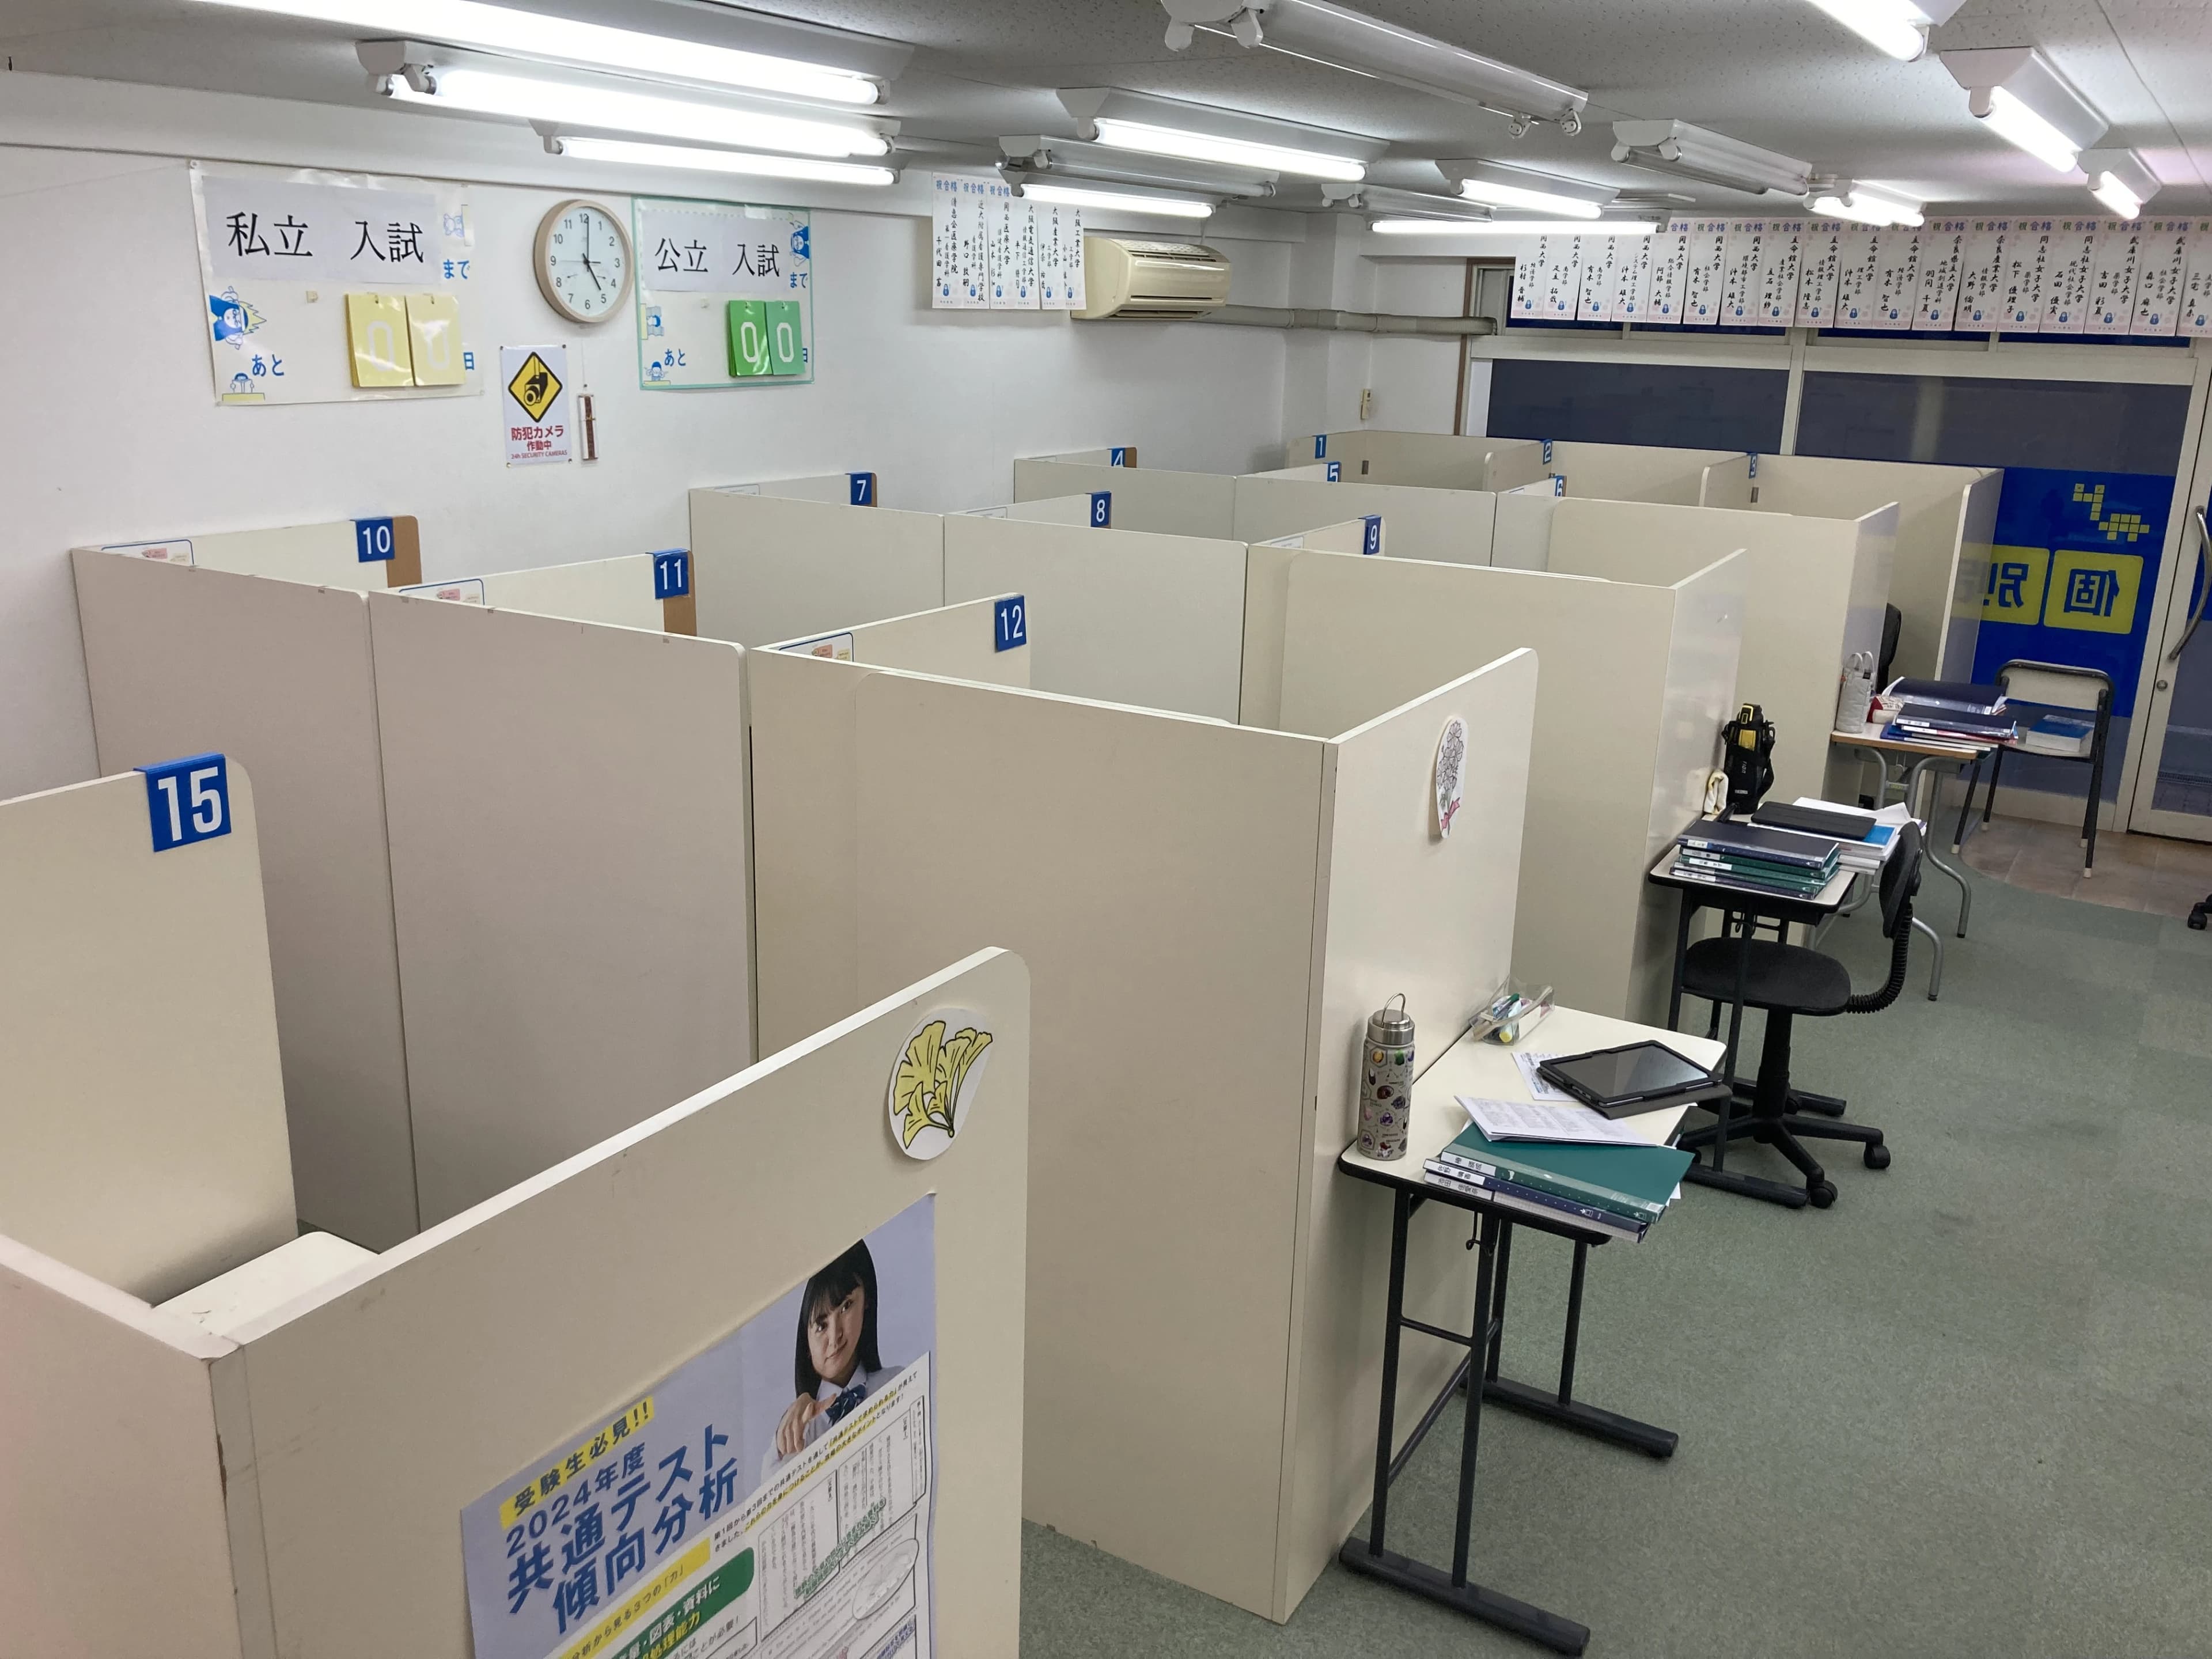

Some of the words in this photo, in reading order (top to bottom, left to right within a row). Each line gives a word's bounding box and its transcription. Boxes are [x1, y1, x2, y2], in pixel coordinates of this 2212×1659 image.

[564, 219, 573, 229] 11
[579, 213, 589, 224] 12
[598, 221, 603, 230] 1
[1698, 223, 1725, 232] 祝合格
[1734, 222, 1763, 232] 祝合格
[1772, 222, 1801, 232] 祝合格
[1811, 222, 1840, 232] 祝合格
[1933, 222, 1964, 231] 祝合格
[1975, 221, 2008, 231] 祝合格
[2018, 221, 2052, 231] 祝合格
[2063, 221, 2096, 231] 祝合格
[2108, 221, 2142, 231] 祝合格
[226, 211, 313, 256] 私立
[350, 221, 425, 263] 入試
[554, 233, 563, 244] 10
[609, 236, 615, 247] 2
[550, 256, 556, 266] 9
[654, 238, 709, 274] 公立
[732, 243, 780, 278] 入試
[1538, 235, 1547, 267] 関西大学
[1571, 235, 1581, 268] 関西大学
[1605, 235, 1615, 268] 関西大学
[1641, 235, 1650, 270] 関西大学
[1676, 236, 1687, 270] 関西大学
[1713, 236, 1724, 271] 関西大学
[1750, 236, 1761, 271] 関西大学
[1786, 236, 1799, 281] 立命館大学
[1826, 236, 1838, 281] 立命館大学
[1865, 236, 1878, 282] 立命館大学
[1906, 235, 1920, 282] 立命館大学
[443, 259, 471, 279] まで
[615, 258, 620, 268] 3
[1946, 234, 1963, 291] 奈良県立大学
[1989, 235, 2005, 293] 奈良産業大学
[2012, 260, 2022, 279] 松下
[2031, 235, 2049, 302] 同志社女子大学
[2074, 235, 2093, 303] 同志社女子大学
[2120, 236, 2139, 305] 武庫川女子大学
[2166, 236, 2186, 305] 武庫川女子大学
[556, 277, 562, 287] 8
[611, 278, 616, 288] 4
[790, 271, 808, 289] まで
[1656, 267, 1664, 283] 阿部
[1766, 267, 1775, 285] 立石
[1805, 268, 1814, 286] 松本
[1815, 259, 1825, 302] 情報理工学部
[1854, 267, 1864, 296] 理工学部
[1967, 271, 1976, 290] 大野
[2054, 271, 2064, 288] 石田
[2064, 260, 2078, 306] 現代社会学部
[2098, 270, 2109, 289] 吉田
[568, 293, 574, 304] 7
[585, 300, 590, 309] 6
[601, 294, 607, 304] 5
[664, 348, 687, 367] あと
[740, 321, 760, 363] 0
[776, 322, 795, 363] 0
[251, 354, 285, 377] あと
[463, 351, 475, 370] 日
[511, 425, 564, 441] 防犯カメラ
[527, 441, 552, 452] 作動中
[1319, 437, 1324, 456] 1
[1544, 442, 1551, 462] 2
[1113, 450, 1124, 467] 4
[1750, 456, 1756, 476] 3
[1329, 464, 1339, 483] 5
[856, 480, 867, 501] 7
[1556, 479, 1563, 497] 6
[1096, 498, 1106, 523] 8
[362, 525, 391, 555] 10
[1370, 524, 1378, 550] 9
[660, 558, 684, 591] 11
[1000, 604, 1024, 641] 12
[157, 766, 222, 842] 15
[514, 1400, 651, 1517] 受験生必見!!
[506, 1442, 646, 1558] 2024年度
[508, 1423, 729, 1613] 共通テスト
[552, 1457, 738, 1635] 傾向分析
